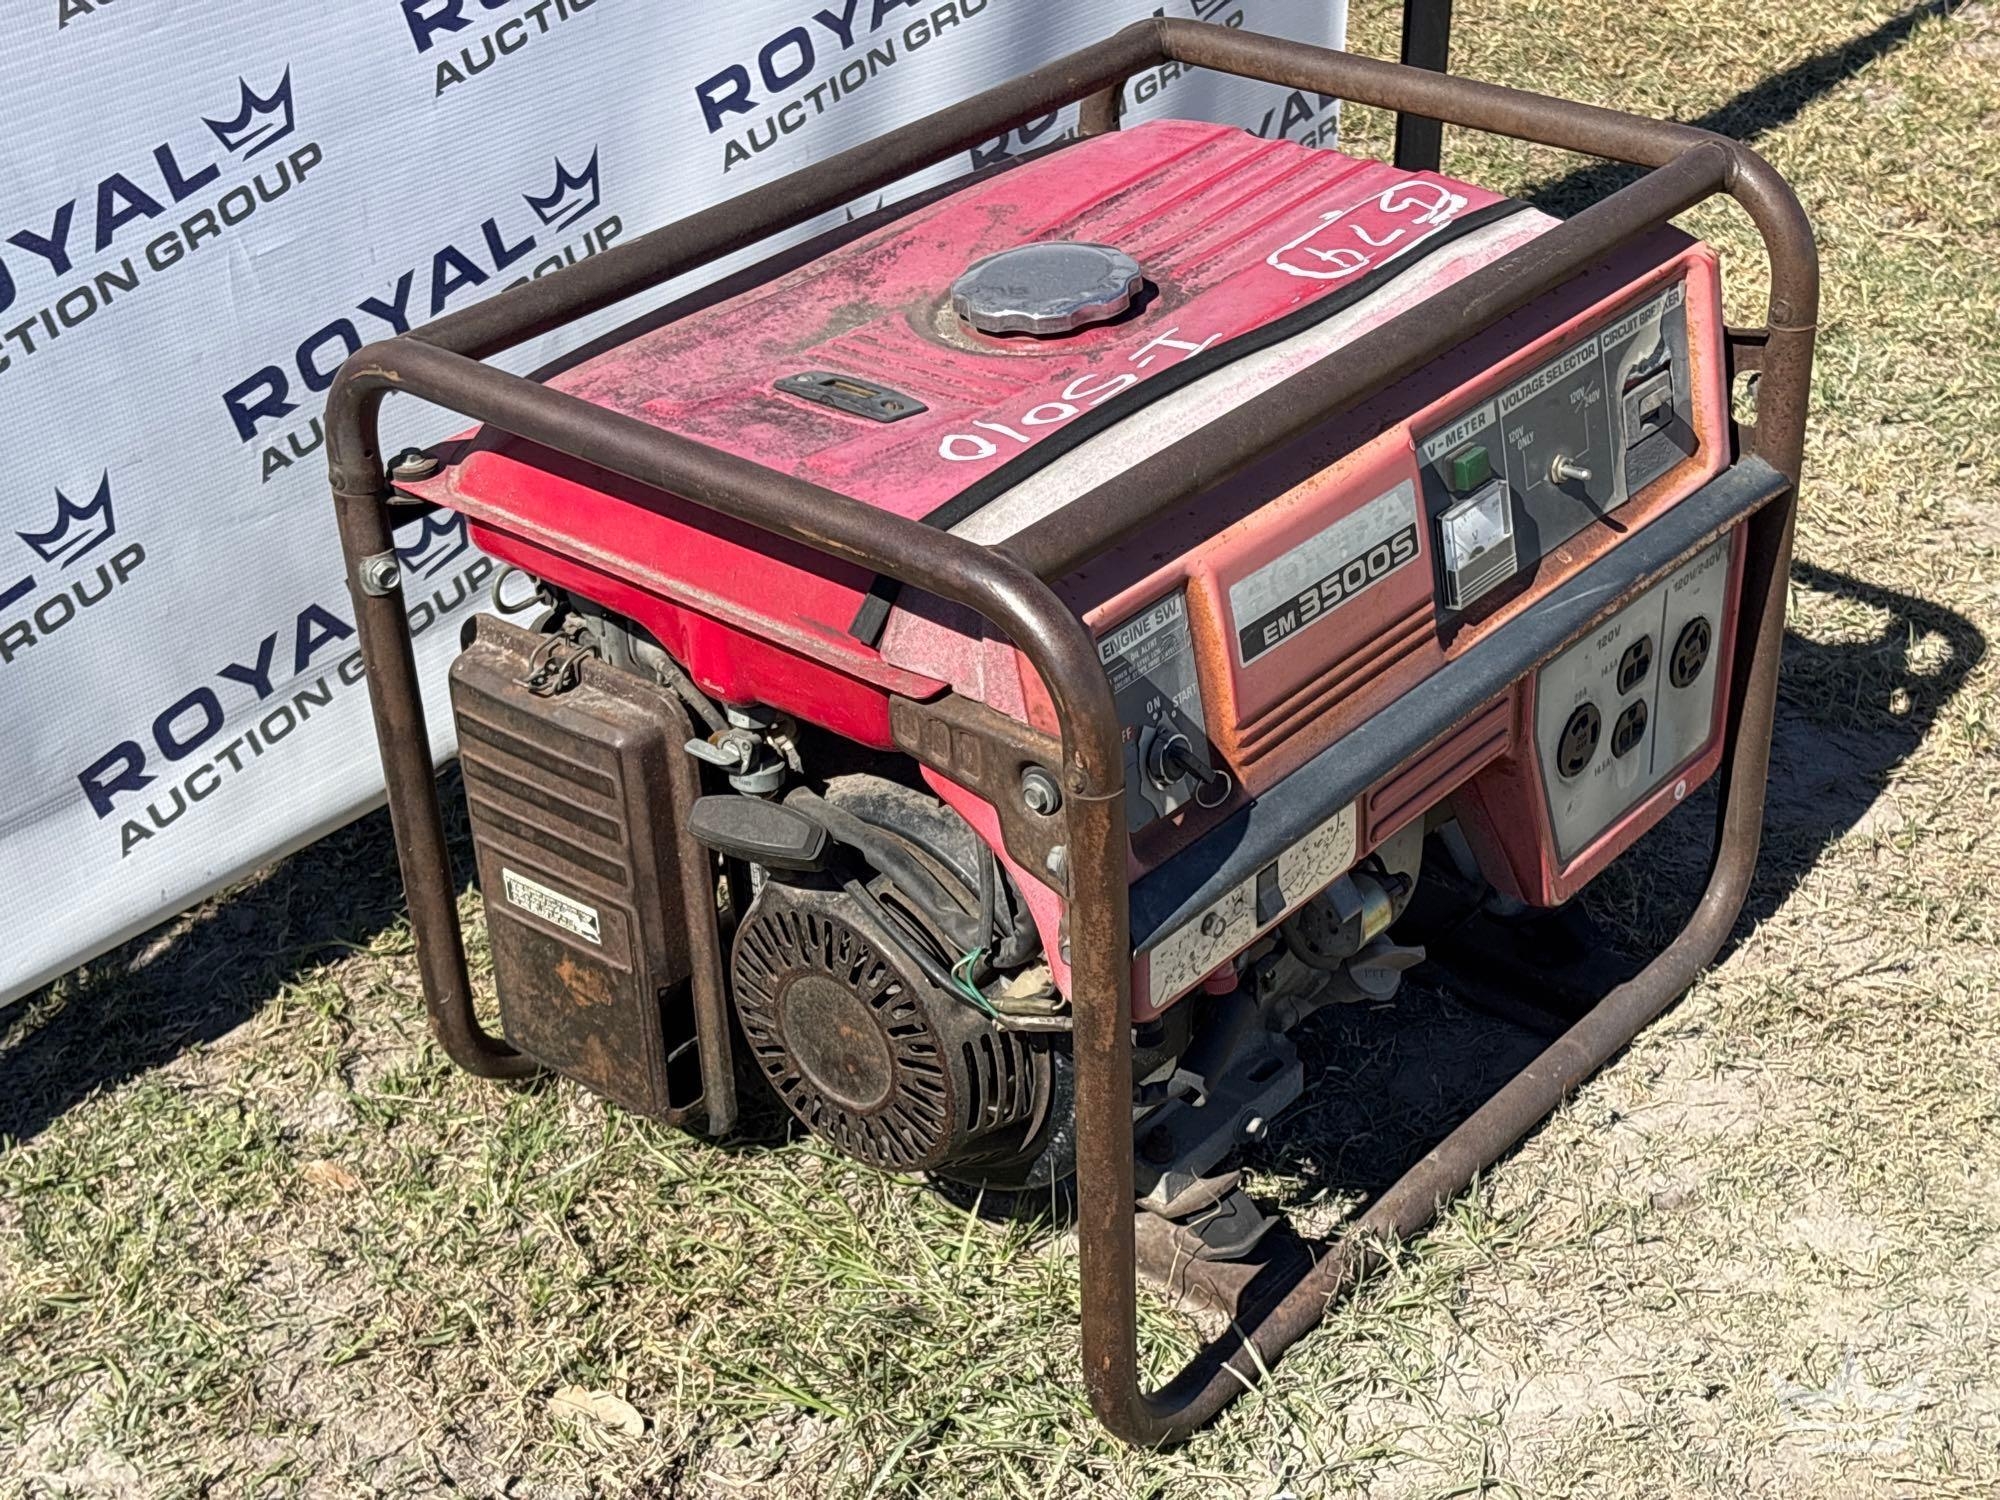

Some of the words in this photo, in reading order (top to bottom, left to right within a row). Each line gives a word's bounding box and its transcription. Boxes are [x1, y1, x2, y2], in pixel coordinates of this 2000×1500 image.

[723, 38, 897, 174] AUCTION
[0, 142, 221, 314] YAL
[145, 142, 322, 272] GROUP
[222, 217, 537, 443] ROYAL
[1603, 316, 1638, 347] CIRCUIT
[1501, 374, 1545, 411] VOLTAGE
[1546, 343, 1596, 384] SELECTOR
[1426, 411, 1487, 459] V-METER
[1517, 430, 1535, 451] ONLY
[1102, 617, 1152, 660] ENGINE
[1154, 600, 1180, 625] SW.
[1597, 623, 1622, 650] 120V
[77, 602, 355, 820] ROYA
[1146, 695, 1161, 715] ON
[1172, 682, 1198, 708] START
[121, 677, 334, 858] AUCTION
